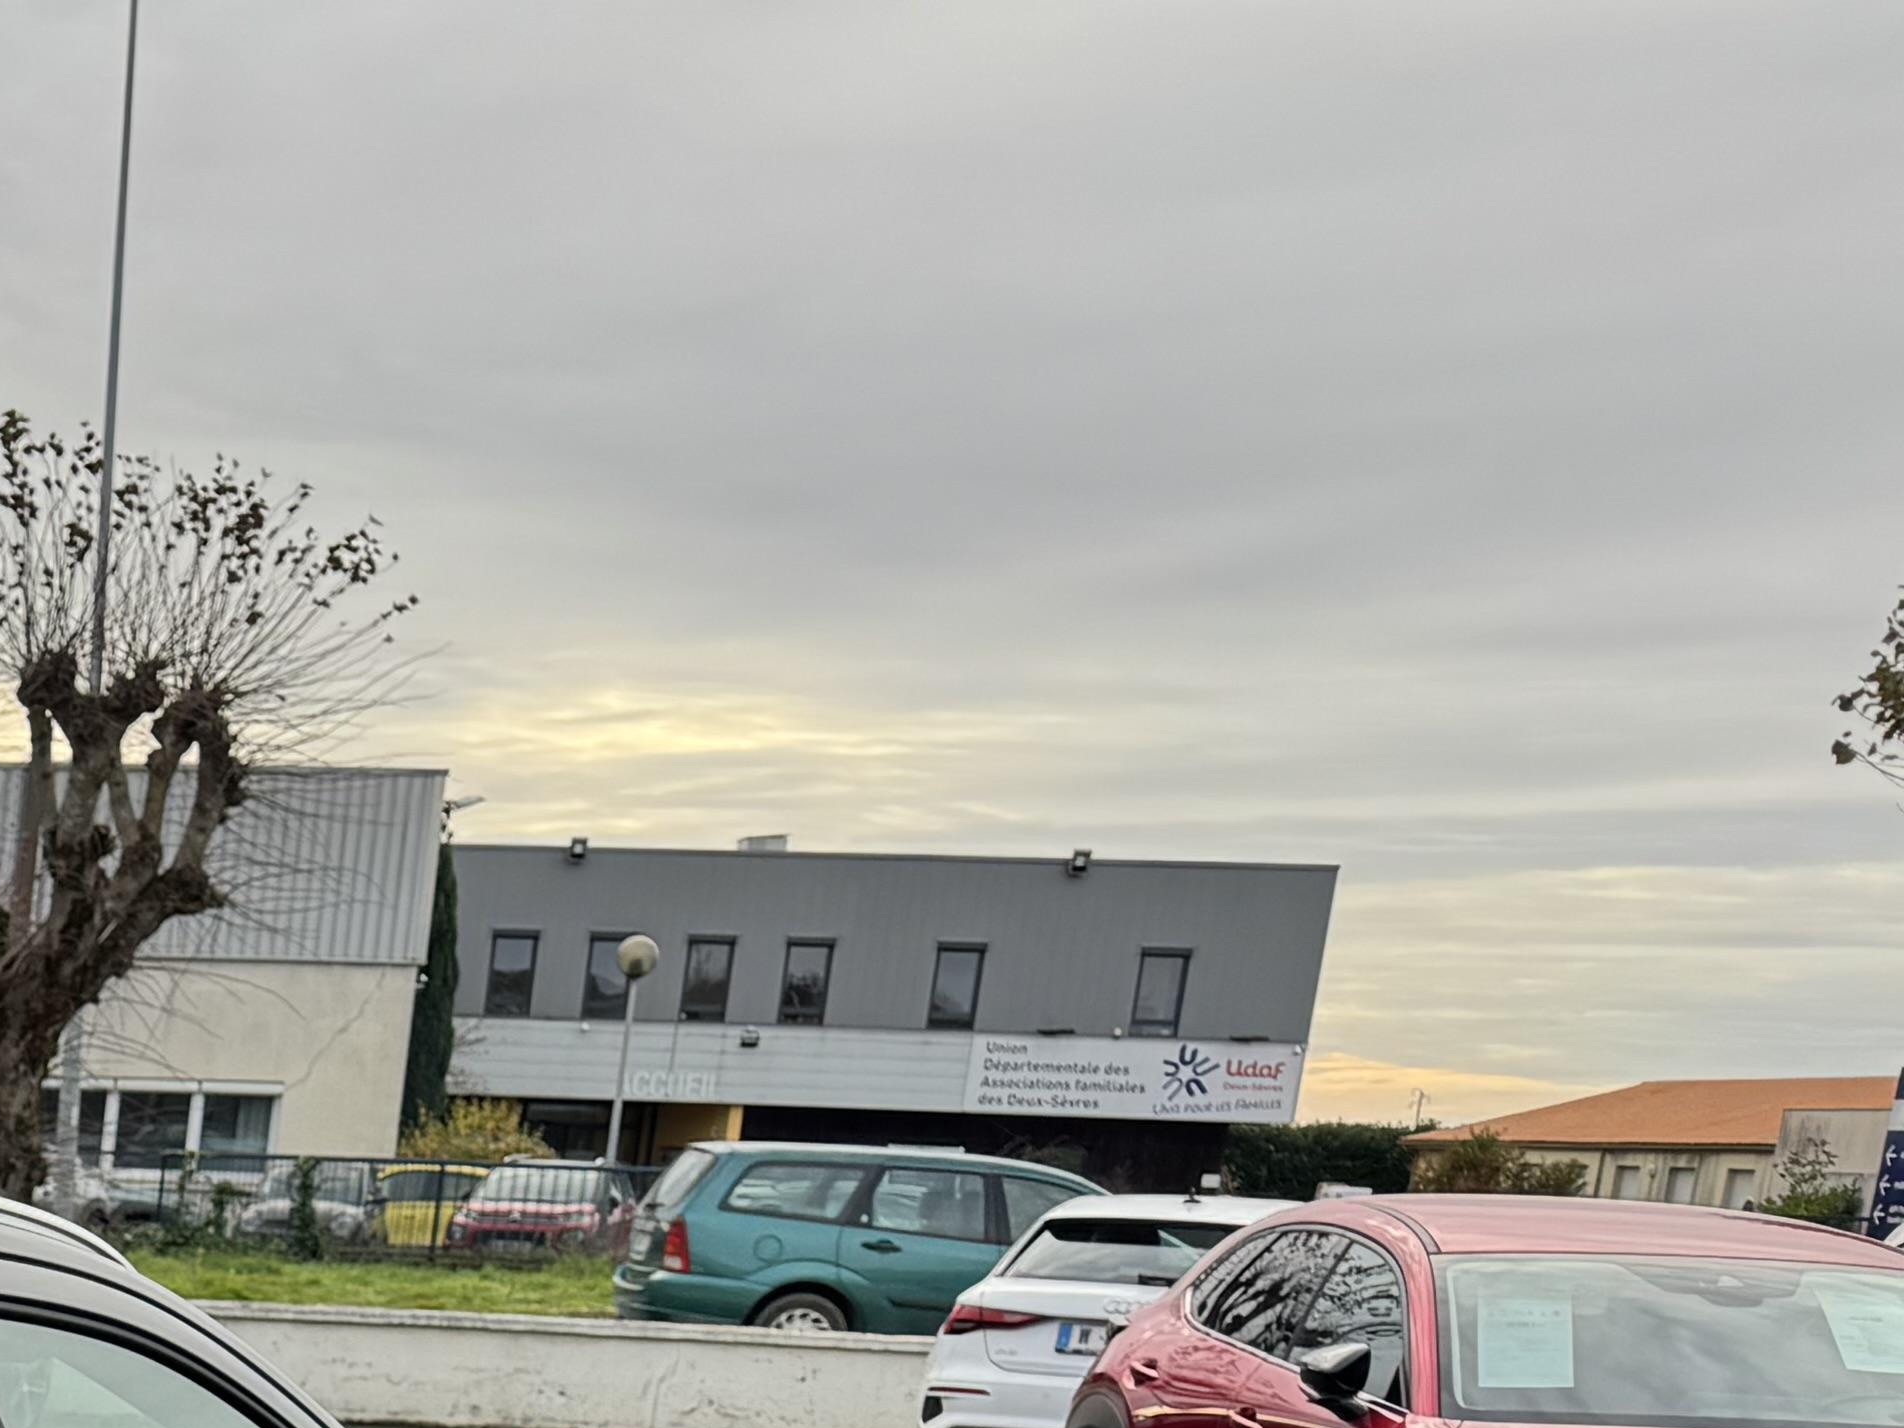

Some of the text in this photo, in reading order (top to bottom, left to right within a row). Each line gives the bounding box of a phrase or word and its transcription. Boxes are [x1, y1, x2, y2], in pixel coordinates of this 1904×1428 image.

[986, 1041, 1028, 1055] Union
[983, 1057, 1130, 1076] Départementale des
[1225, 1058, 1286, 1080] Udaf
[980, 1075, 1146, 1094] Associations familiales
[977, 1092, 1003, 1106] des
